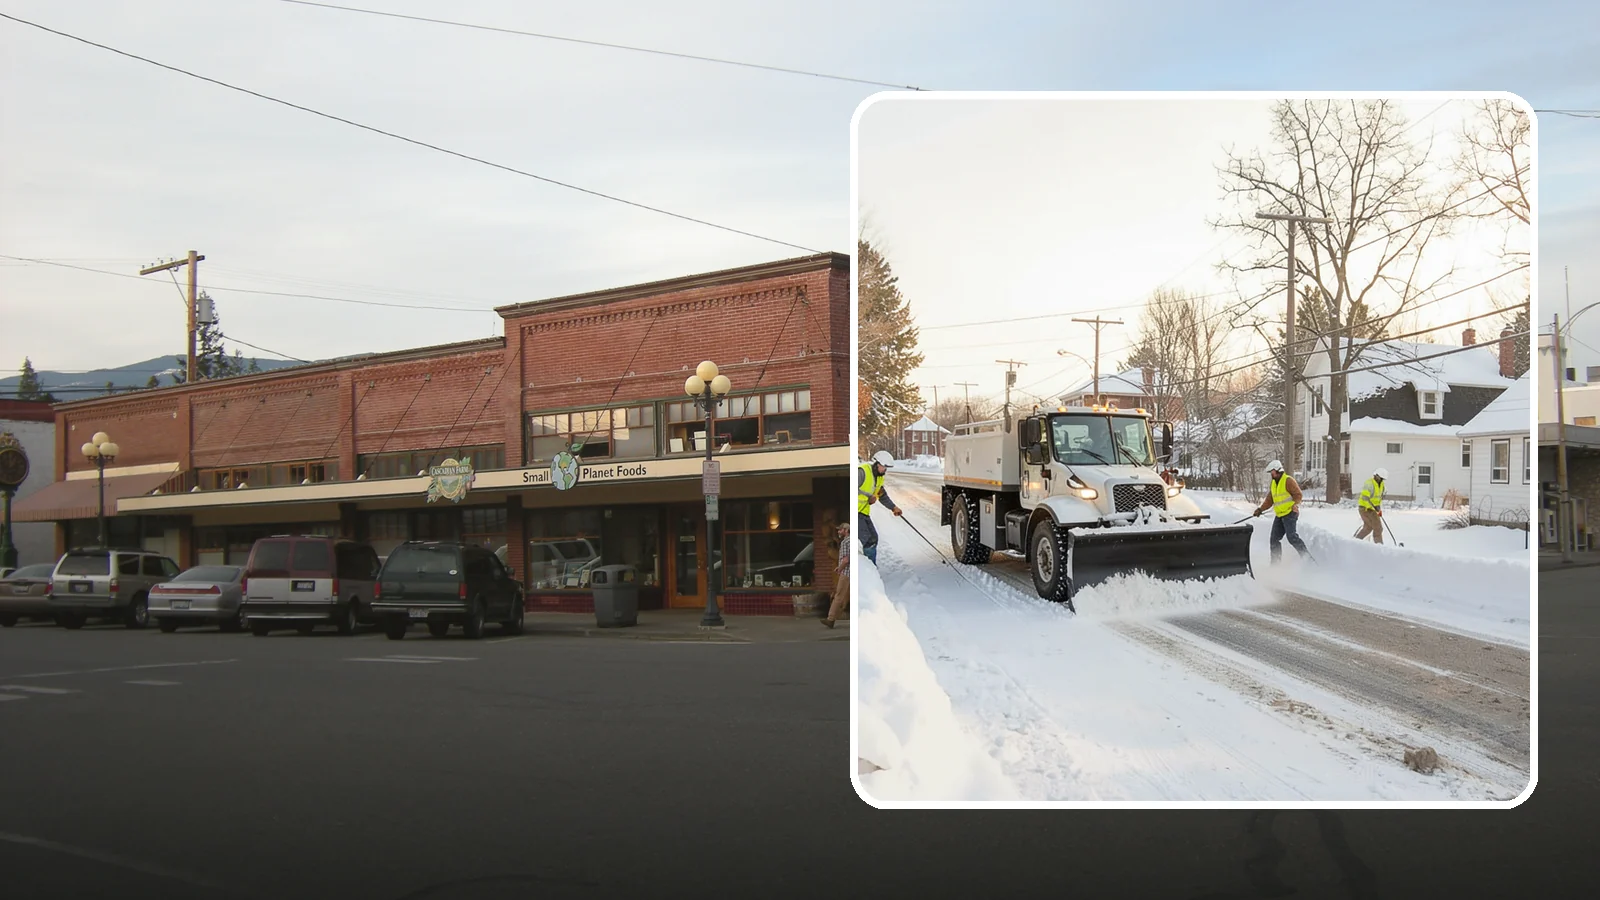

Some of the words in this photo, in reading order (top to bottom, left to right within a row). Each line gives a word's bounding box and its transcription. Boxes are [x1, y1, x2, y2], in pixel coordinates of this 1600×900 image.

[523, 471, 549, 483] Small
[583, 468, 614, 479] Planet
[617, 465, 647, 477] Foods
